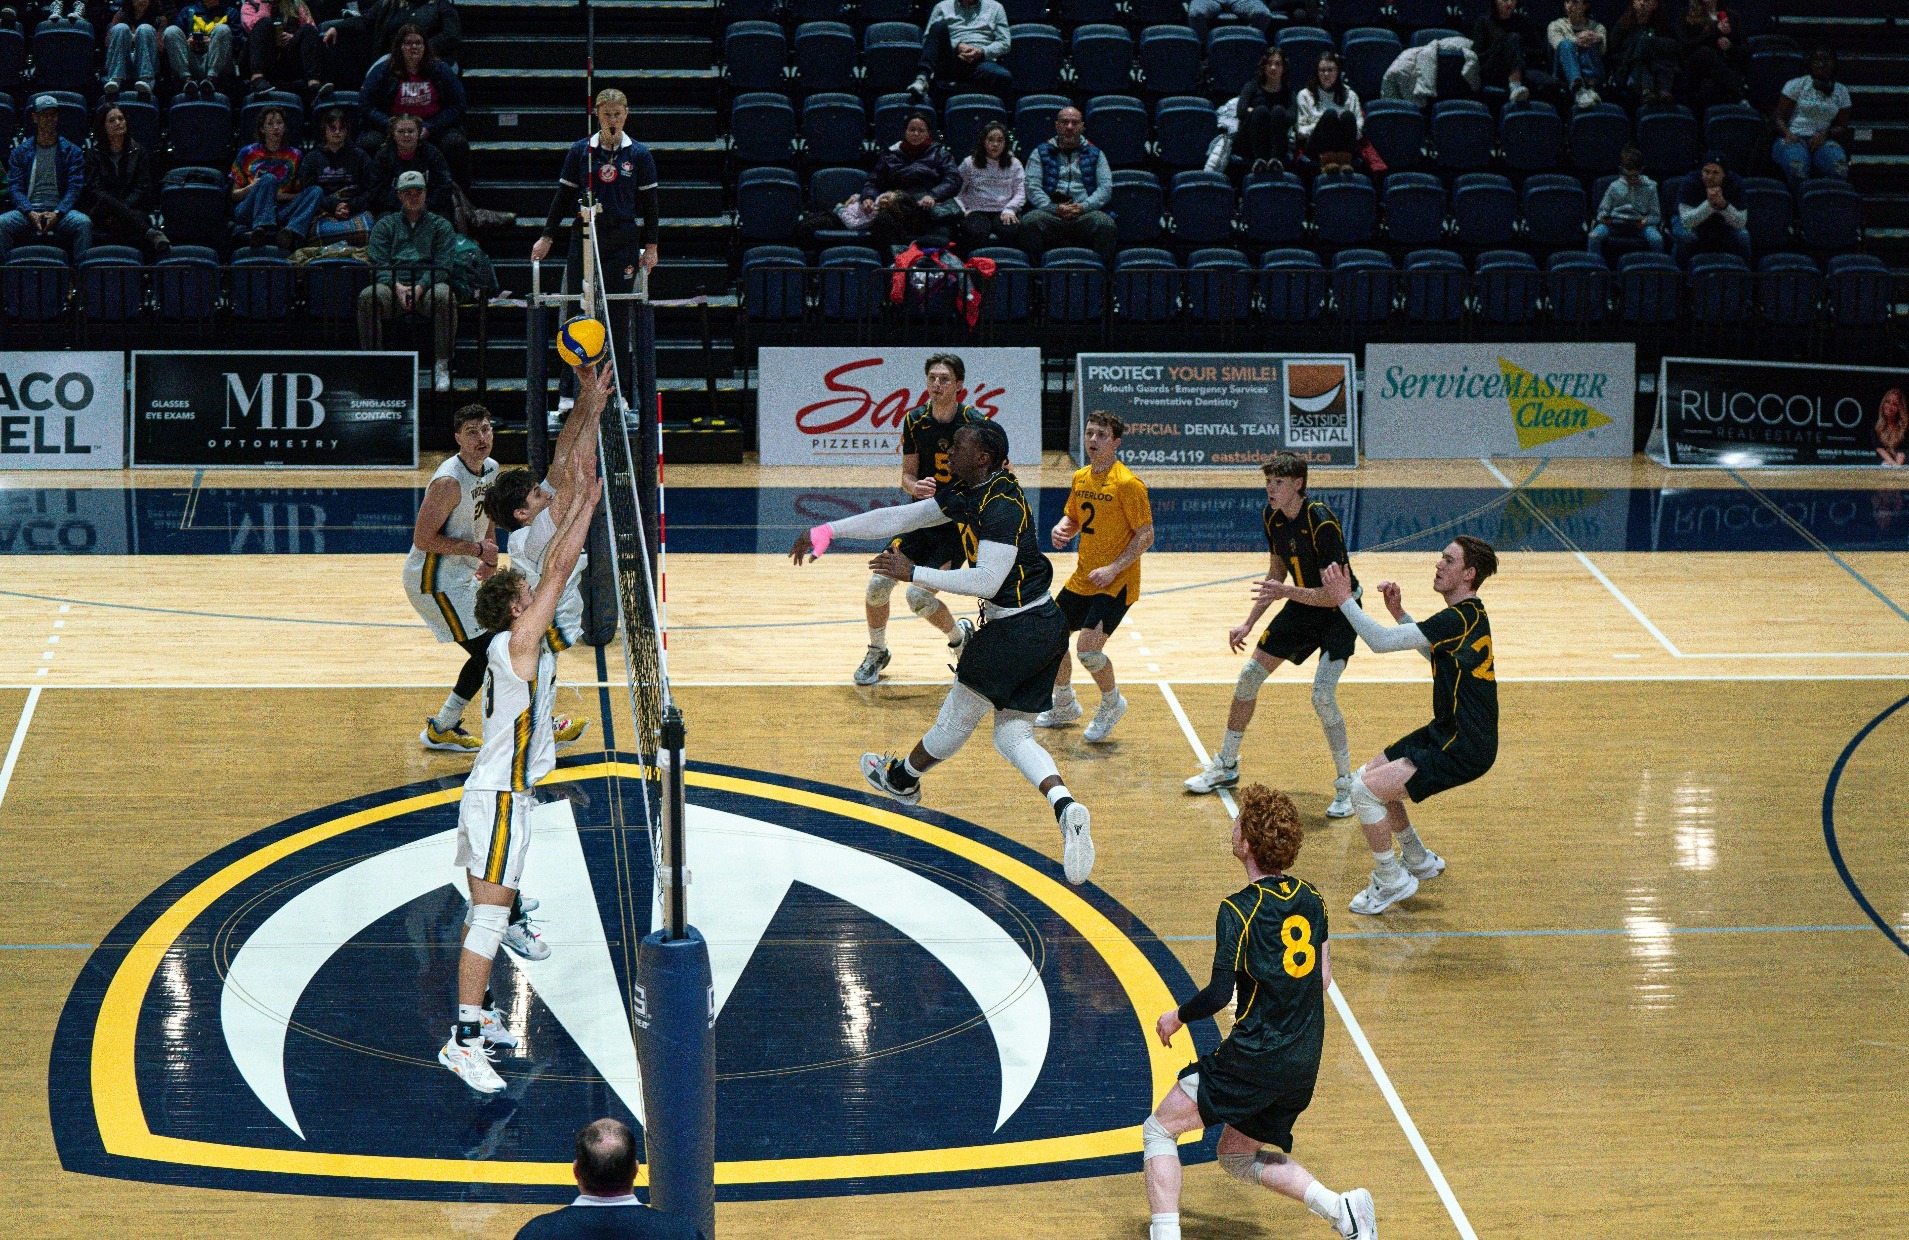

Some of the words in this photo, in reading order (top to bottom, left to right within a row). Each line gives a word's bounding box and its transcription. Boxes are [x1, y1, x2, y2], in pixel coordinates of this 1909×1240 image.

[1088, 365, 1163, 380] PROTECT
[1168, 366, 1217, 381] YOUR
[1221, 367, 1277, 382] SMILE!
[796, 358, 1006, 434] Sa's
[1103, 384, 1134, 394] Mouth
[1136, 384, 1170, 394] Guards
[1175, 385, 1227, 397] Emergency
[1229, 385, 1268, 395] Services
[151, 400, 190, 408] GLASSES
[221, 372, 326, 430] MB
[350, 399, 407, 408] SUNGLASSES
[1133, 396, 1192, 407] Preventative
[1195, 398, 1239, 409] Dentistry
[145, 411, 162, 420] EYE
[164, 411, 196, 420] EXAMS
[354, 411, 402, 420] CONTACTS
[1516, 402, 1589, 428] Clean
[1681, 390, 1863, 428] RUCCOLO
[1290, 414, 1346, 428] EASTSIDE
[1, 416, 92, 454] ELL
[1123, 423, 1181, 436] OFFICIAL
[1185, 423, 1238, 436] DENTAL
[1241, 424, 1280, 436] TEAM
[1290, 428, 1348, 443] DENTAL
[1717, 426, 1755, 440] REAL
[1764, 428, 1822, 443] ESTATE
[207, 439, 339, 449] OPTOMETRY
[812, 438, 889, 449] PIZZERIA
[1115, 449, 1205, 464] 19-948-4119
[934, 452, 953, 484] 5
[1081, 501, 1095, 534] 2
[1281, 915, 1316, 978] 8
